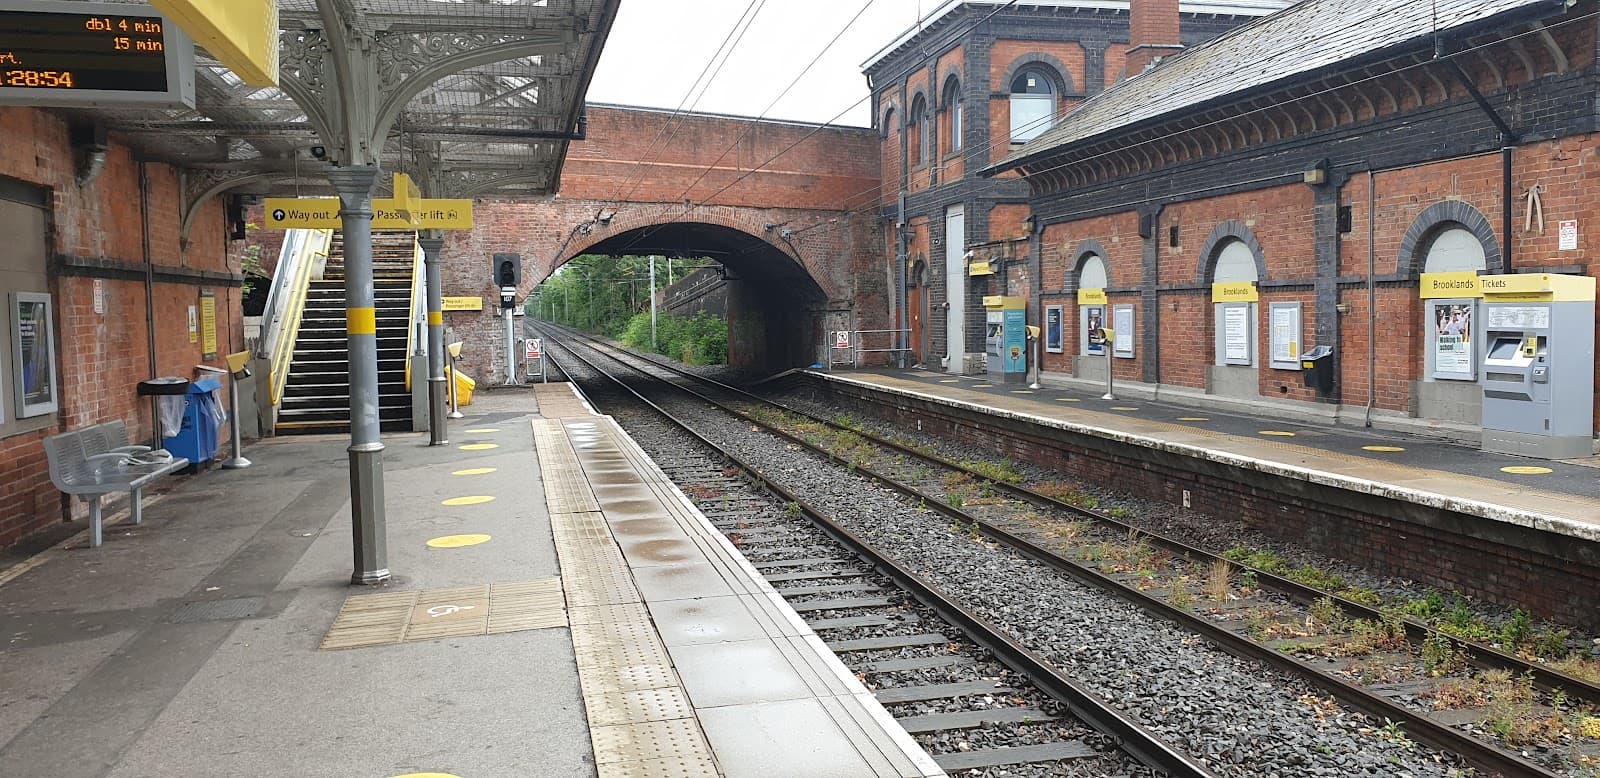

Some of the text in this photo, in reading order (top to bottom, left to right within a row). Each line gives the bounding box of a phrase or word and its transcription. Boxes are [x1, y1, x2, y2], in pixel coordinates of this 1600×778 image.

[85, 18, 161, 33] dbl 4 min
[113, 37, 163, 51] 15 min
[288, 209, 444, 222] Way out Passer lift
[1433, 278, 1507, 290] Brooklands Tickets
[1223, 288, 1248, 296] Brooklands
